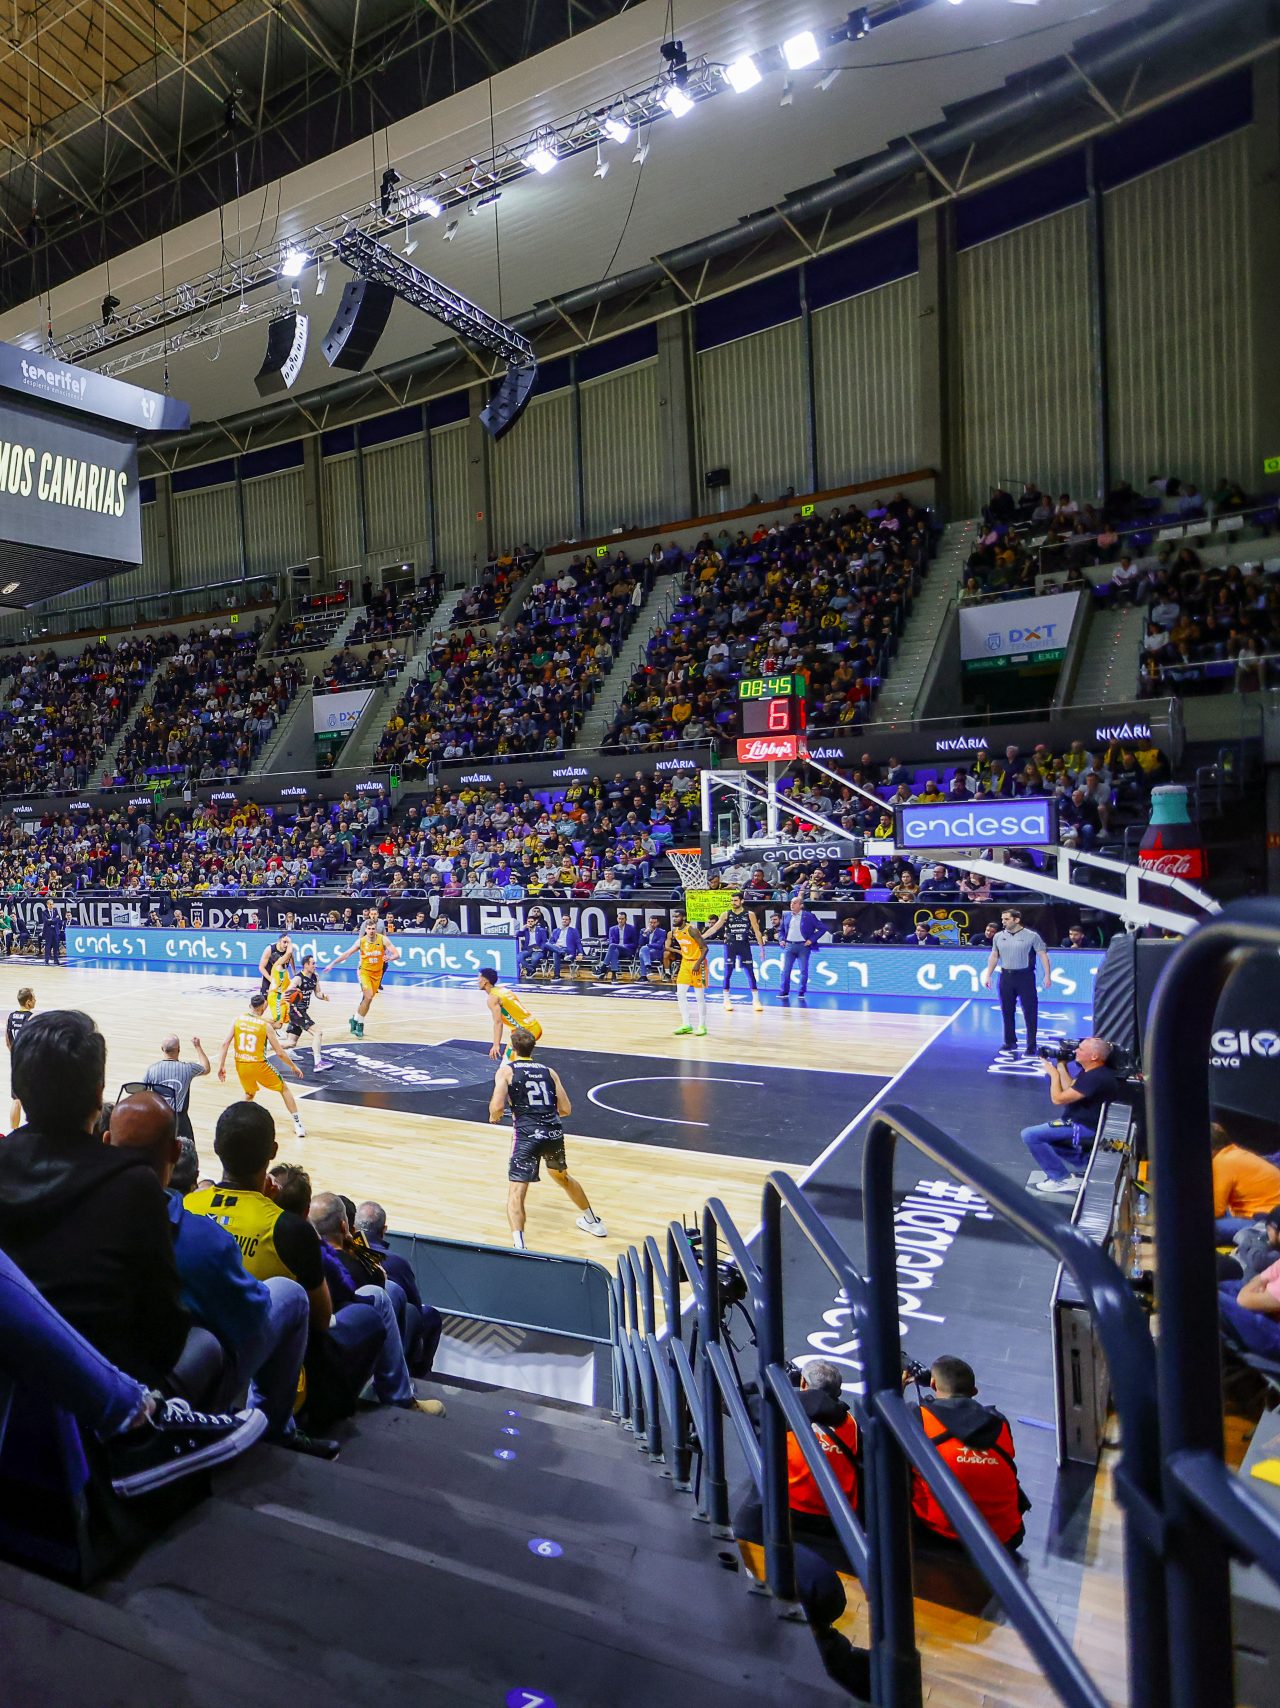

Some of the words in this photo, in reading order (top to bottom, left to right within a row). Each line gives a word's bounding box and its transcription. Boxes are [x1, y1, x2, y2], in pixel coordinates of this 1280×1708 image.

[21, 360, 86, 400] tenerife!
[38, 452, 127, 517] CANARIAS
[1009, 624, 1057, 643] DXT
[1038, 651, 1060, 661] EXIT
[740, 677, 791, 697] 08:45
[770, 700, 788, 729] 6
[742, 741, 793, 759] Libby's
[936, 736, 988, 751] NIVARIA
[809, 747, 844, 758] VARIA
[656, 758, 695, 770] NIVARIA
[460, 773, 491, 783] NIVARIA
[553, 766, 588, 777] NIVARIA
[281, 786, 306, 795] NIVARIA
[356, 781, 383, 791] NIVARIA
[129, 797, 152, 805] NIVARIA
[211, 791, 235, 800] NIVARIA
[13, 805, 33, 813] NIVARIA
[906, 813, 1045, 839] endesa
[763, 845, 841, 862] endesa
[238, 1033, 258, 1052] 13
[525, 1081, 550, 1105] 21
[500, 1450, 508, 1459] 4
[538, 1541, 552, 1555] 6
